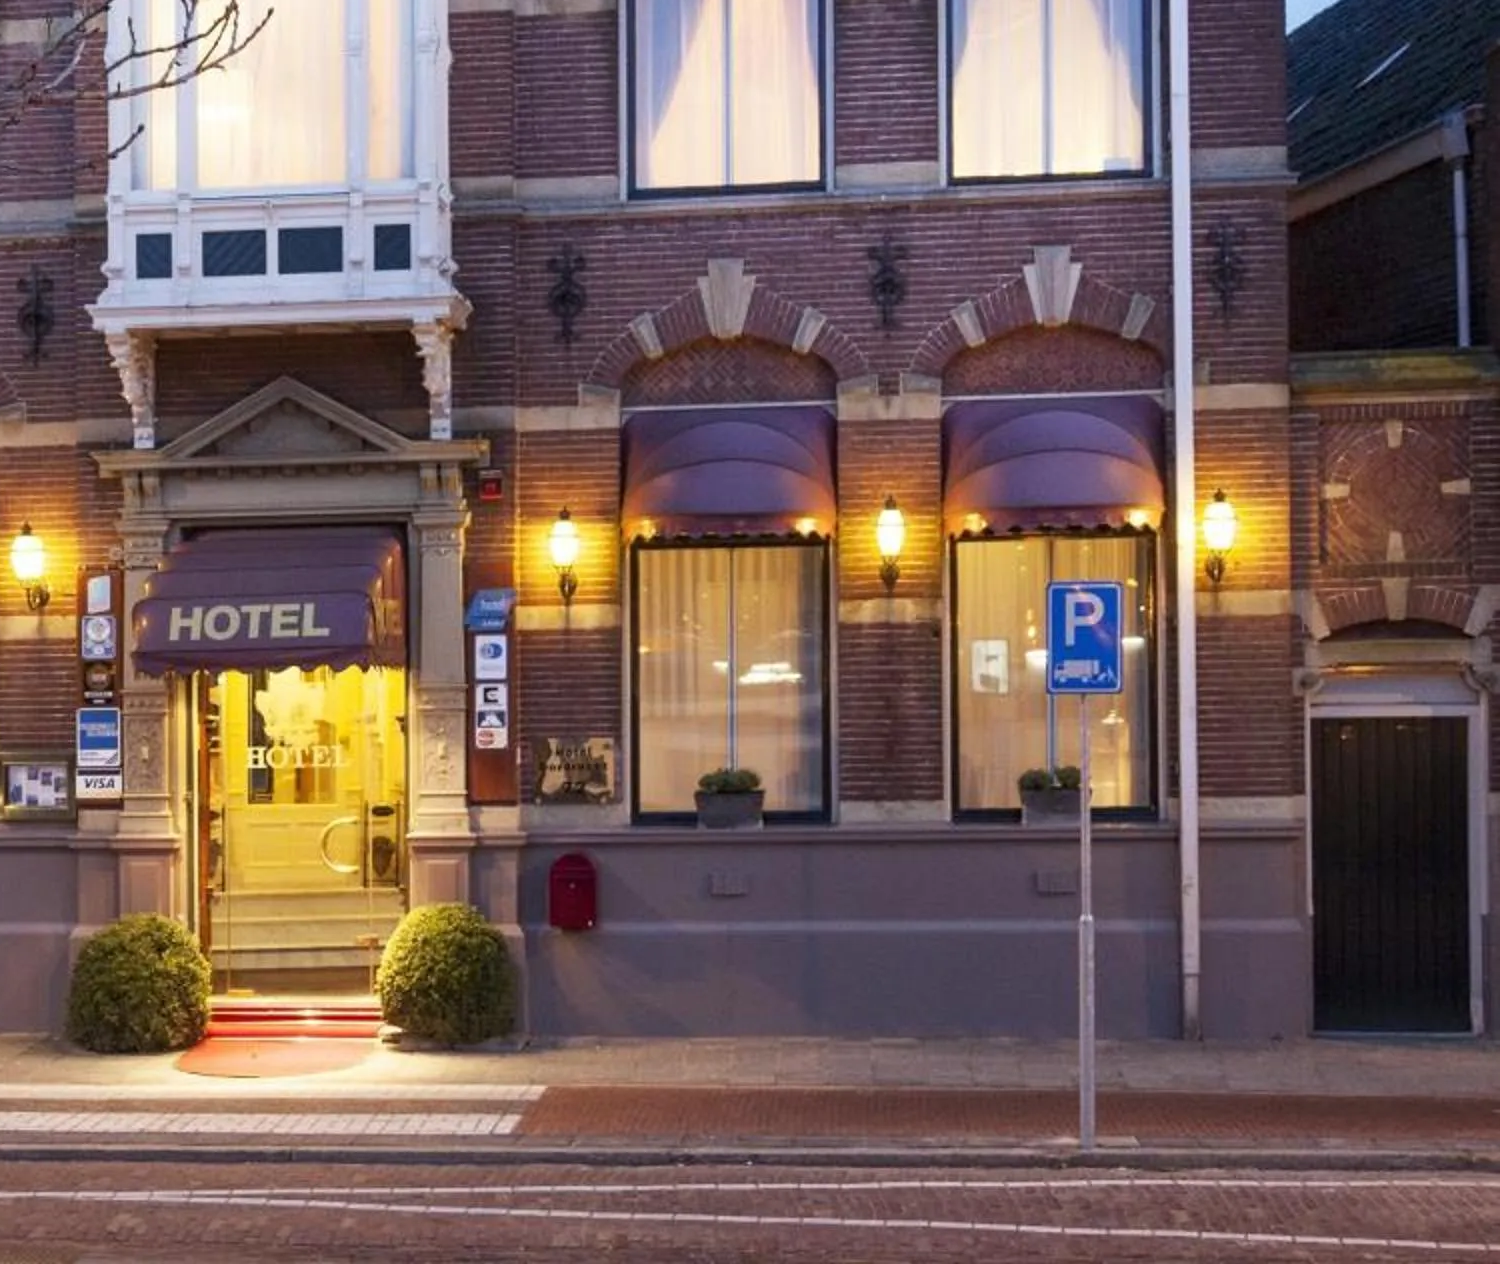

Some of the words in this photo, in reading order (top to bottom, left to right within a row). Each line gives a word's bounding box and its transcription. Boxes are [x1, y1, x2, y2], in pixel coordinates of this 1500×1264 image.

[168, 602, 331, 641] HOTEL
[1065, 592, 1105, 647] P
[246, 744, 351, 769] HOTEL
[84, 777, 115, 789] VISA
